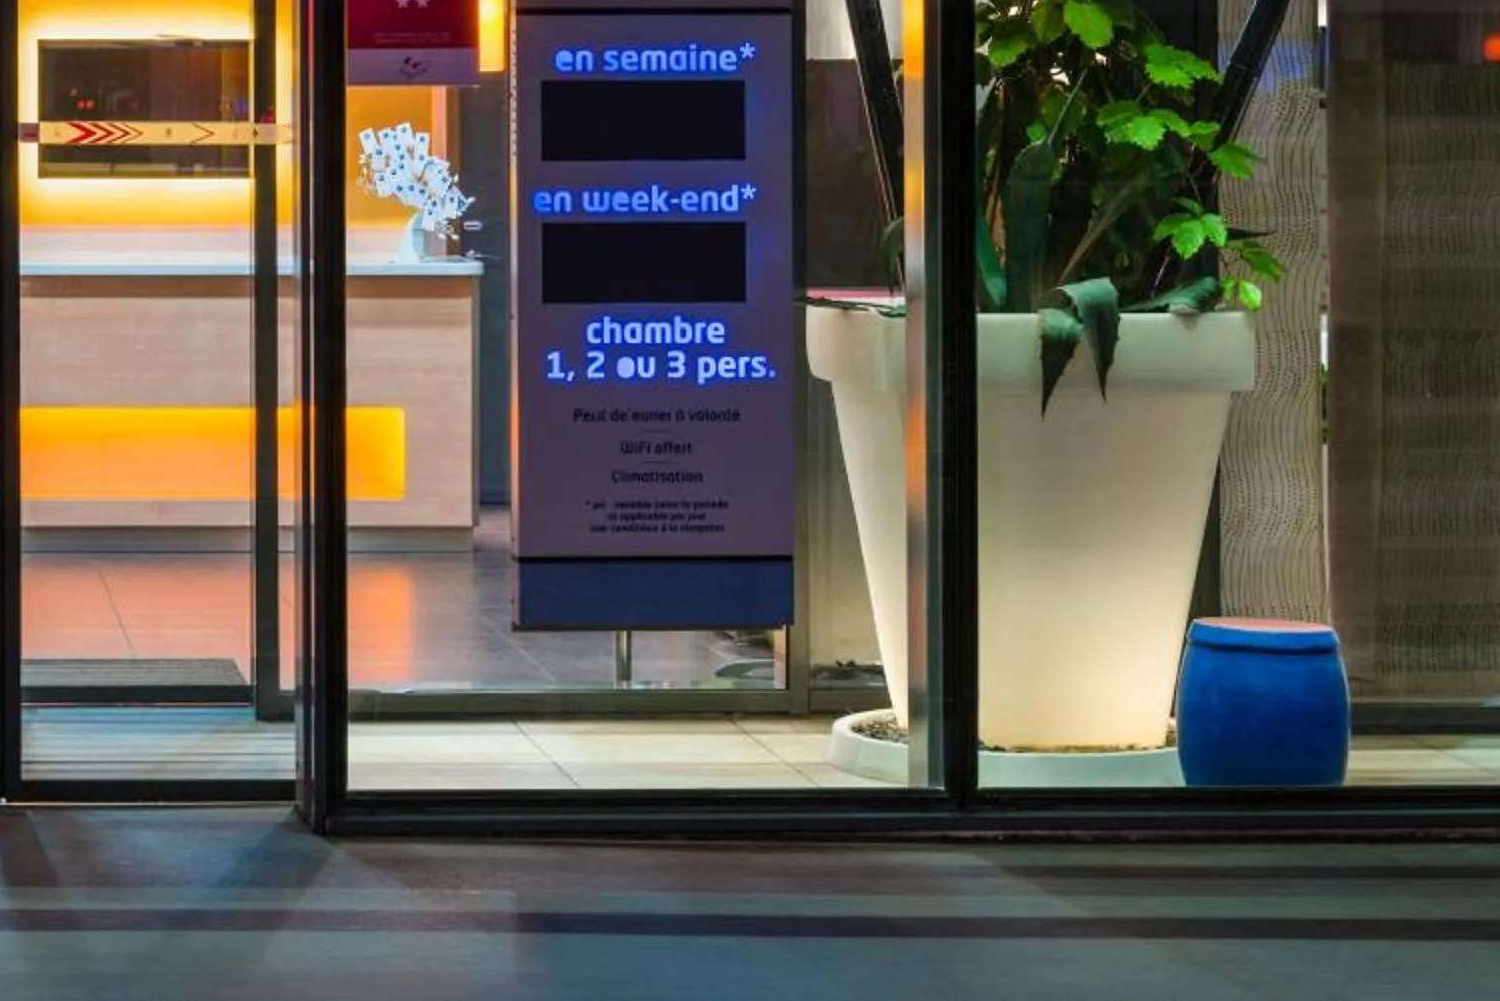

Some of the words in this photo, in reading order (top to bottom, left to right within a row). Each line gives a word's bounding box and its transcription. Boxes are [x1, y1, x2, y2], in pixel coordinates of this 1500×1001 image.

[555, 49, 593, 71] en
[533, 190, 571, 212] en
[586, 316, 726, 344] chambre
[547, 351, 575, 382] 1,
[586, 351, 605, 378] 2
[616, 356, 655, 379] ou
[667, 351, 686, 378] 3
[697, 355, 776, 385] pers.
